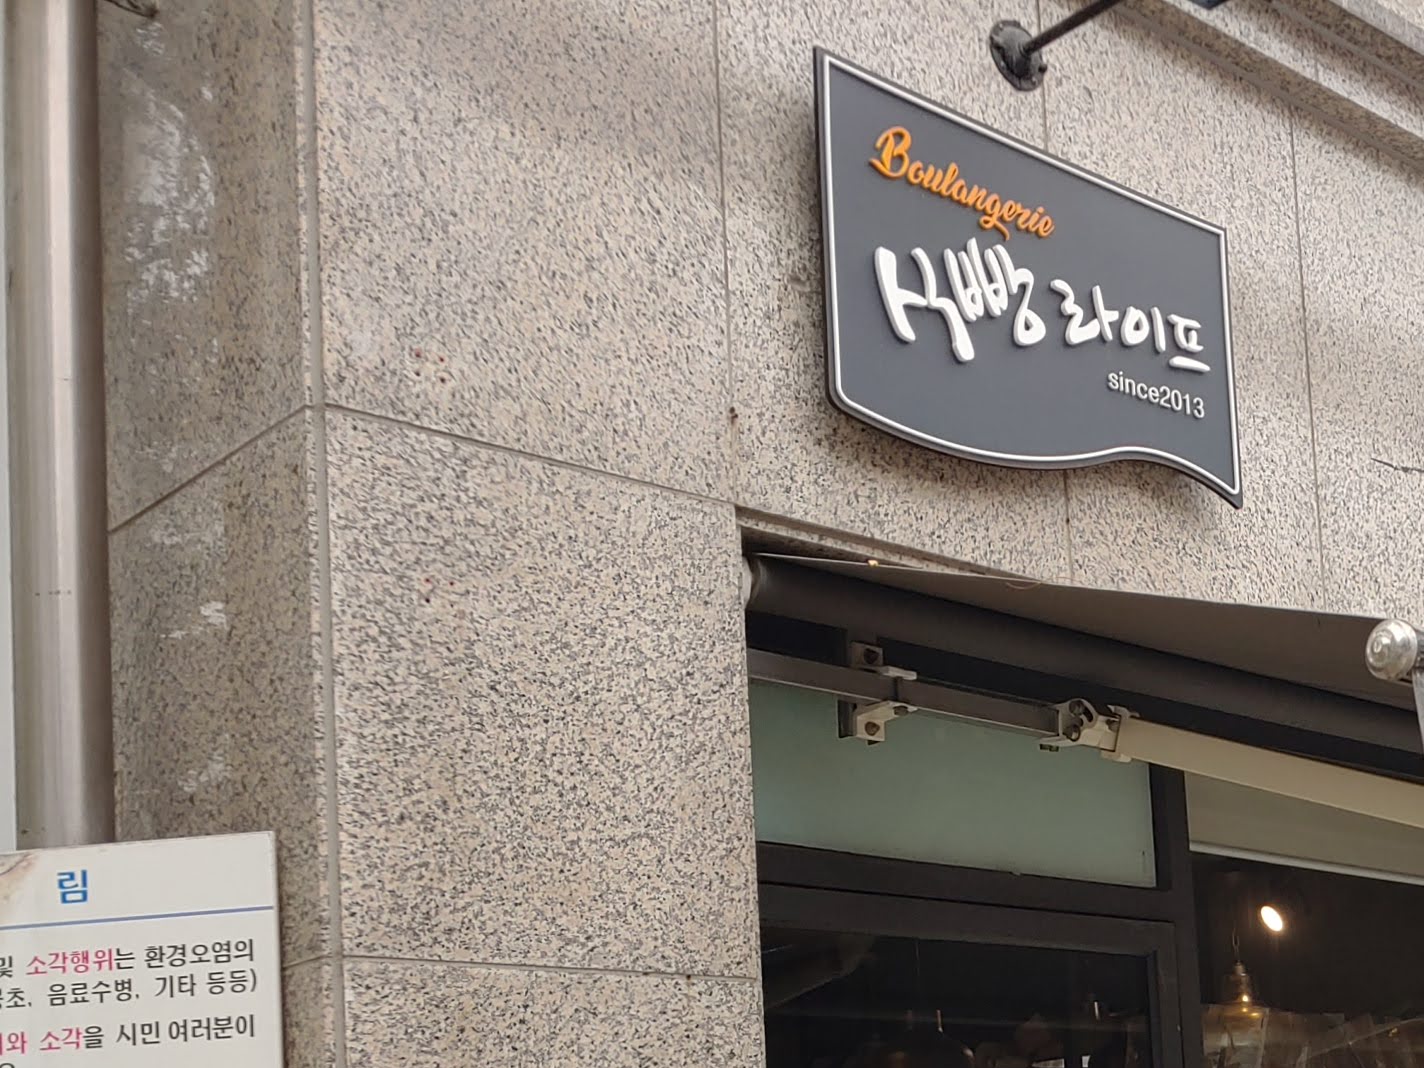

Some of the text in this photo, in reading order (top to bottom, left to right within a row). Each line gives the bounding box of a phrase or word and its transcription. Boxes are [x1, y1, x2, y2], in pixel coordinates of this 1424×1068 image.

[869, 126, 1056, 239] Boulangerie
[1107, 370, 1205, 418] since2013
[57, 870, 88, 903] 림
[26, 947, 135, 976] 소각행위는
[144, 938, 255, 969] 환경오염의
[0, 968, 257, 1009] 초, 음료수병, 기타 등등)
[0, 1014, 255, 1056] 와 소각을 시민 여러분이
